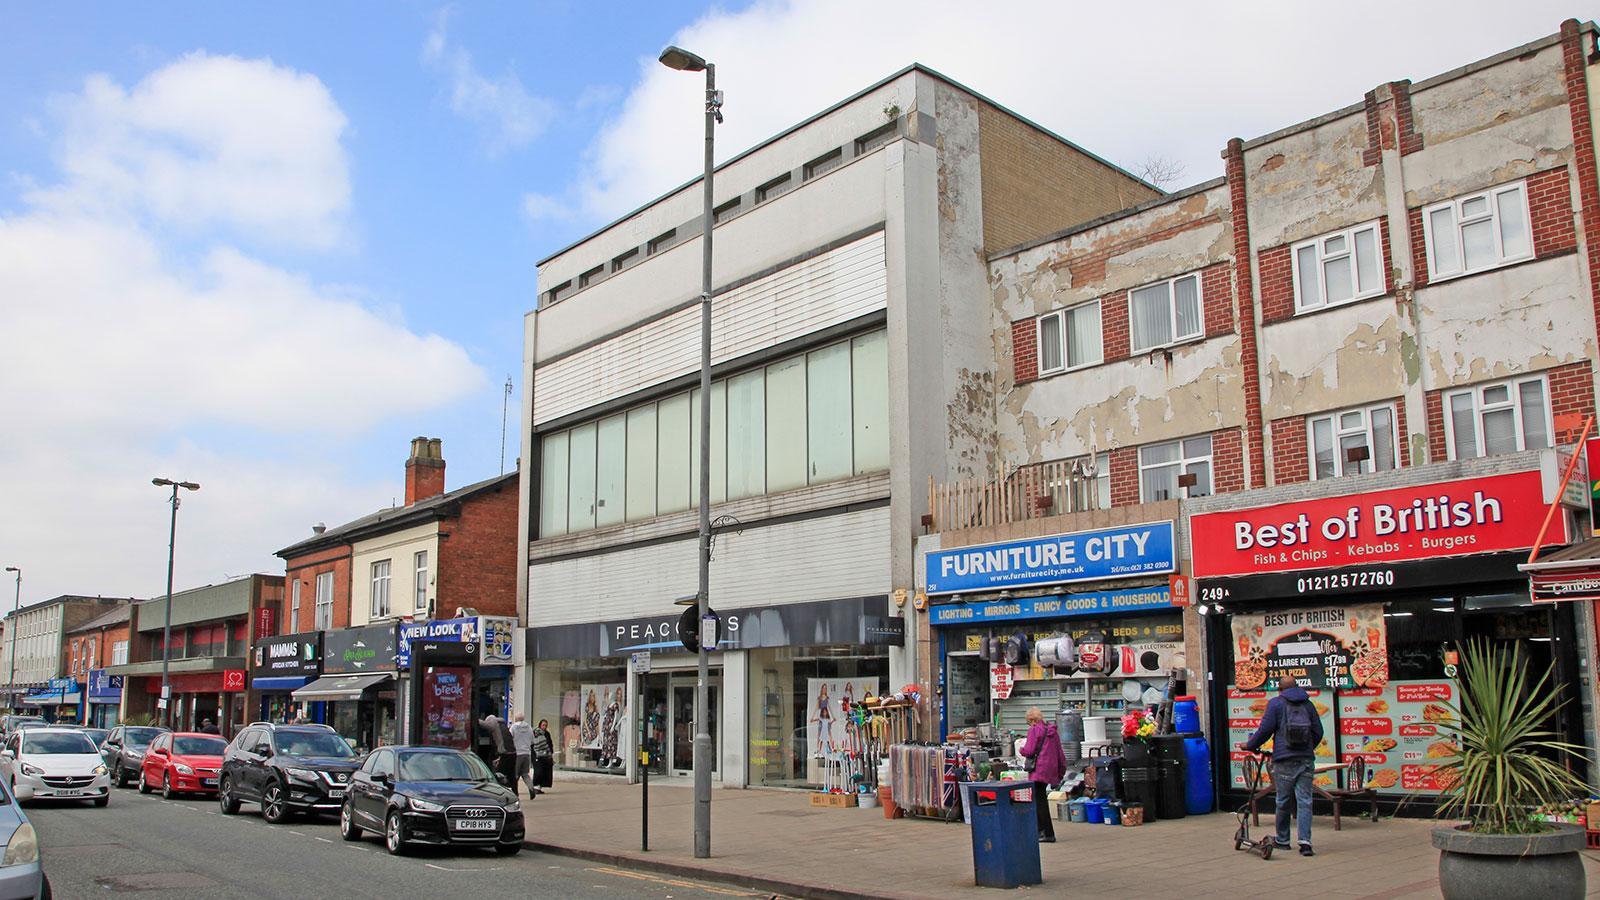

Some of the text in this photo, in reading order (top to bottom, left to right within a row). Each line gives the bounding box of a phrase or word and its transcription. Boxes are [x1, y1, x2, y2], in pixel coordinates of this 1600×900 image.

[1234, 491, 1502, 550] Best of British
[941, 530, 1152, 577] FURNITURE CITY
[1254, 554, 1276, 565] Fish
[1280, 552, 1288, 562] &
[1291, 549, 1328, 563] Chips
[1348, 541, 1400, 556] Kebabs
[1422, 535, 1477, 549] Burgers
[989, 565, 1084, 582] www.furniturecity.me.uk
[1297, 570, 1394, 593] 01212572760
[938, 607, 973, 620] LIGHTING
[984, 604, 1021, 617] MIRRORS
[1034, 600, 1062, 613] FANCY
[1066, 597, 1097, 610] GOODS
[1101, 596, 1108, 607] &
[1112, 592, 1170, 607] HOUSEHOLD
[1264, 609, 1345, 627] BEST OF BRITISH
[430, 624, 456, 637] LOOK
[616, 616, 739, 640] PEACS
[1113, 627, 1138, 637] BEDS
[1155, 624, 1183, 634] BEDS
[270, 642, 298, 658] MAMMAS
[1268, 659, 1273, 667] 3
[1279, 658, 1299, 667] LARGE
[1300, 657, 1318, 666] PIZZA
[1324, 654, 1347, 666] £17.99
[1269, 670, 1274, 678] 2
[1288, 668, 1307, 676] PIZZA
[1325, 666, 1348, 677] £17.99
[434, 683, 464, 696] break
[1269, 680, 1275, 688] 3
[1326, 677, 1349, 687] £11.99
[460, 820, 492, 829] CP18 HYS
